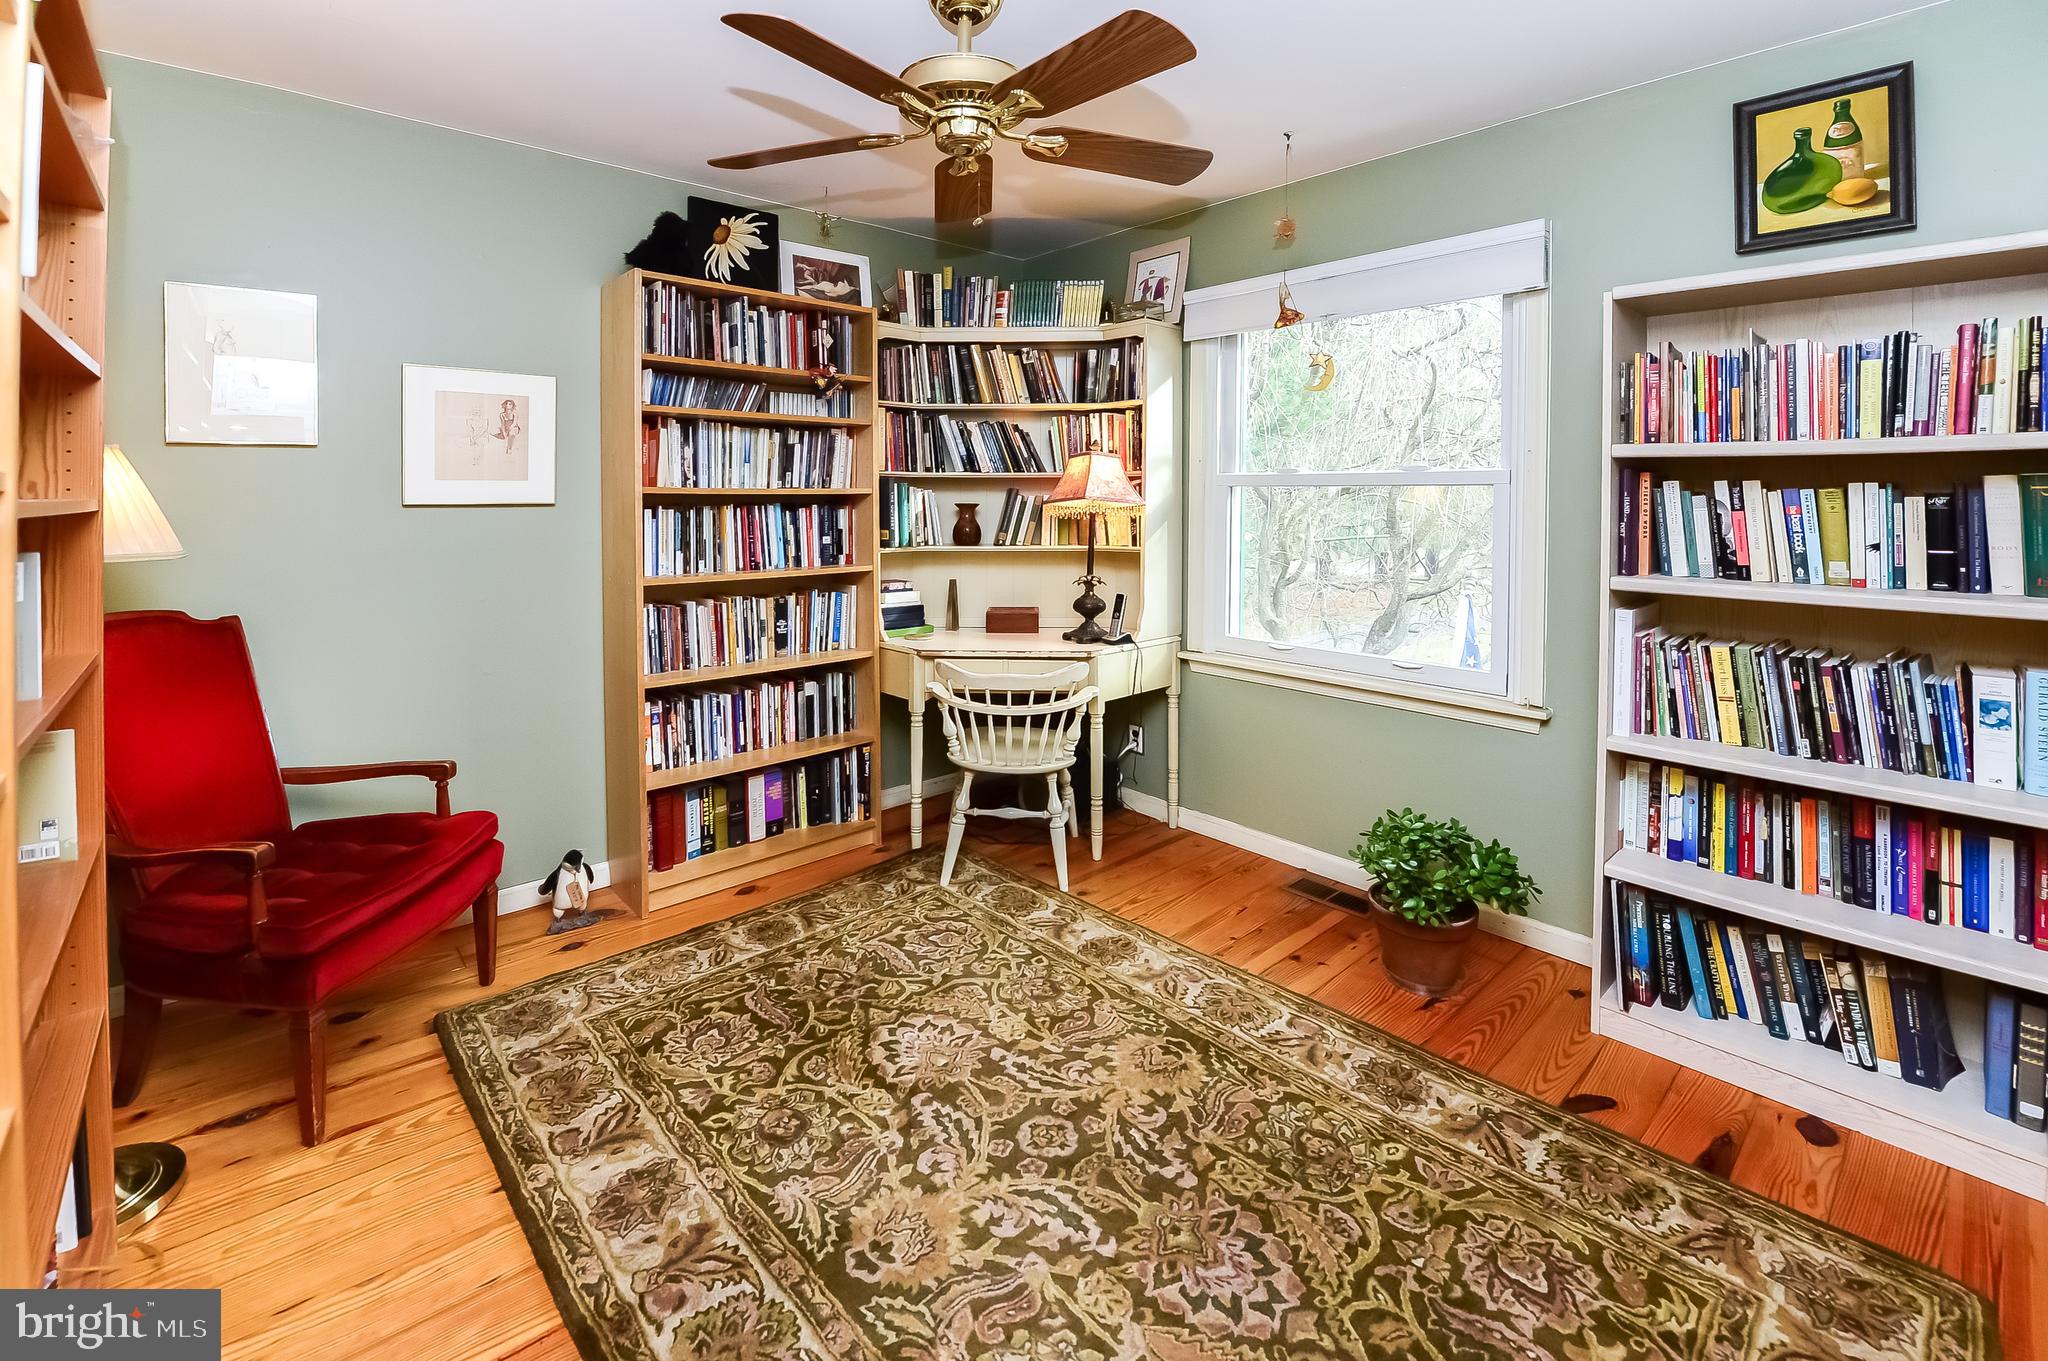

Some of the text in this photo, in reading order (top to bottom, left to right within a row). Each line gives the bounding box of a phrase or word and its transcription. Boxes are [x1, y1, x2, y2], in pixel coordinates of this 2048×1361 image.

[1623, 496, 1631, 514] HAND
[1791, 514, 1806, 554] beat book
[1716, 651, 1730, 695] robert hass
[2038, 677, 2048, 761] GERALD STERN
[1636, 900, 1645, 929] Procession
[1662, 913, 1678, 994] TROUBLING THE LINE
[1705, 946, 1723, 1000] THE CRAFTY POET
[1775, 953, 1791, 1001] WESTERN WIND
[1764, 986, 1778, 1022] BILL MOYERS
[1834, 994, 1845, 1013] Walking
[1848, 1002, 1864, 1029] FINDING
